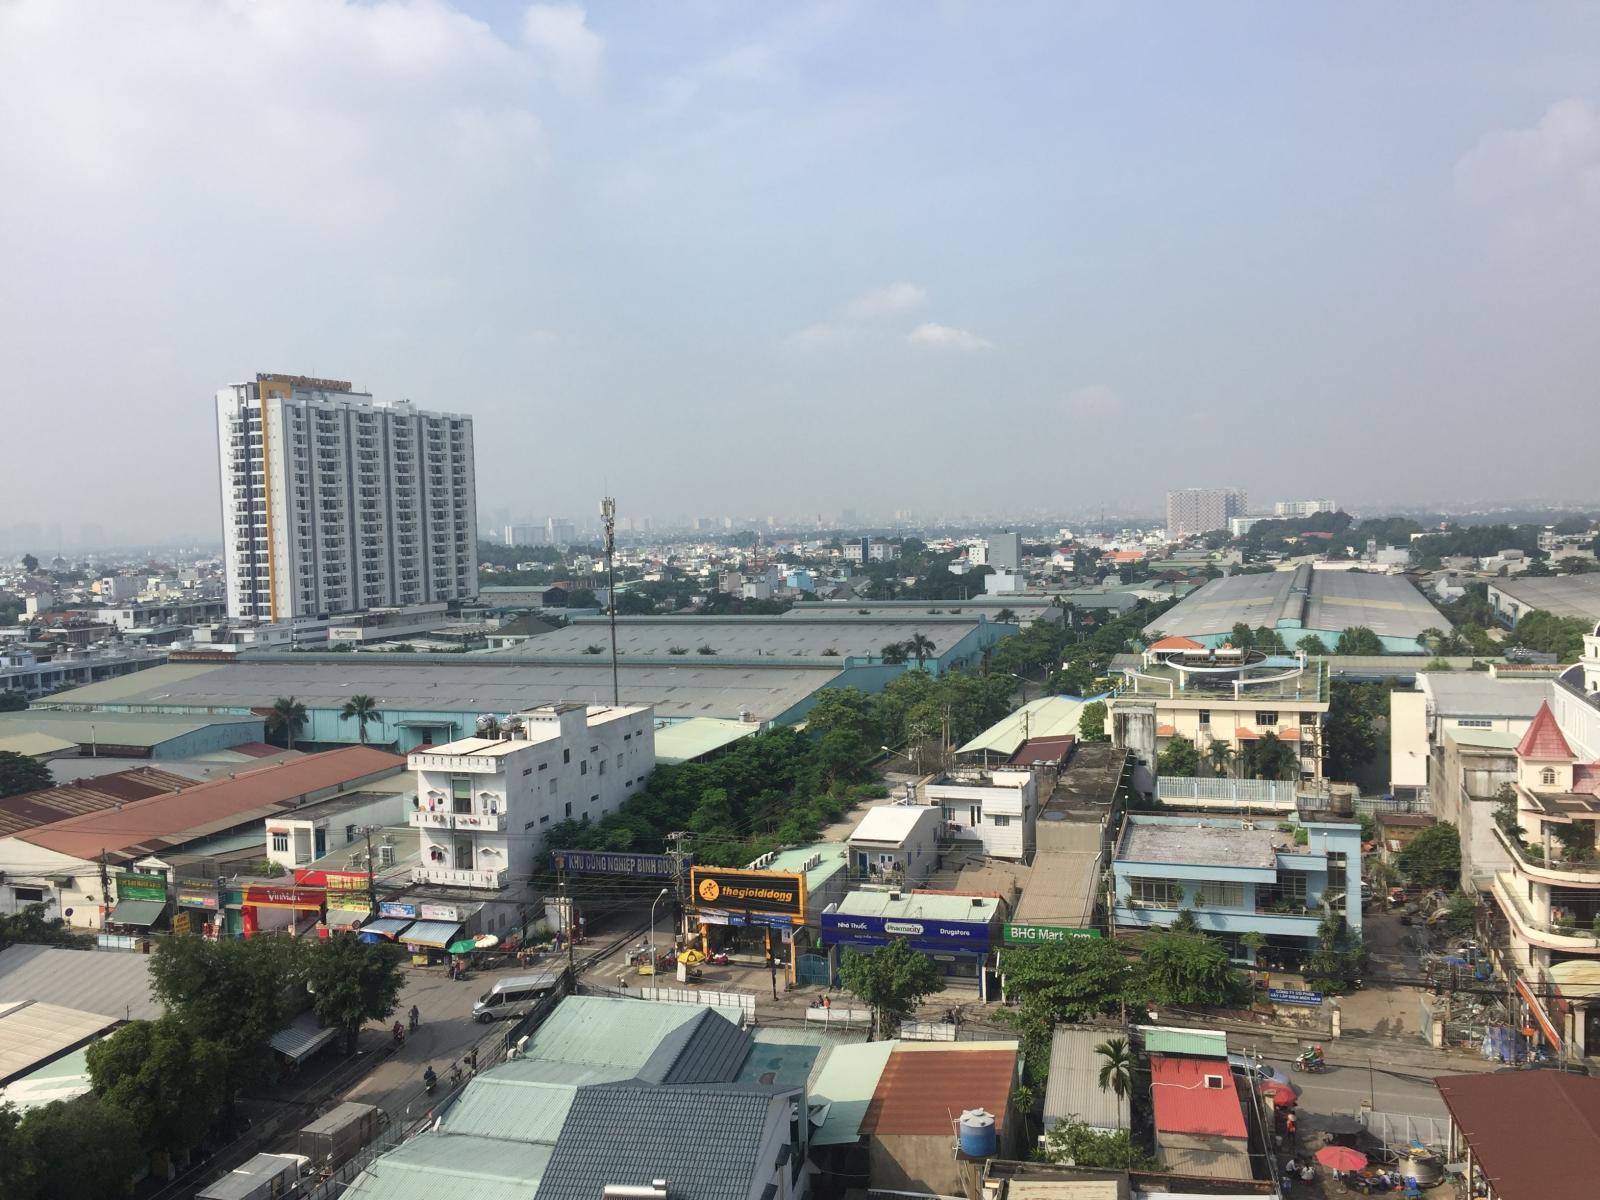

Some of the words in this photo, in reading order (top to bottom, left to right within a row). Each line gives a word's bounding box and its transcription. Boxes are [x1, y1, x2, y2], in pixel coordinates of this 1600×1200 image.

[568, 855, 584, 870] KHU
[722, 886, 793, 902] thegioididong
[886, 923, 921, 934] Pharmacity
[939, 928, 970, 937] Drugstore
[1010, 927, 1036, 939] BHG
[1038, 928, 1064, 941] Mart
